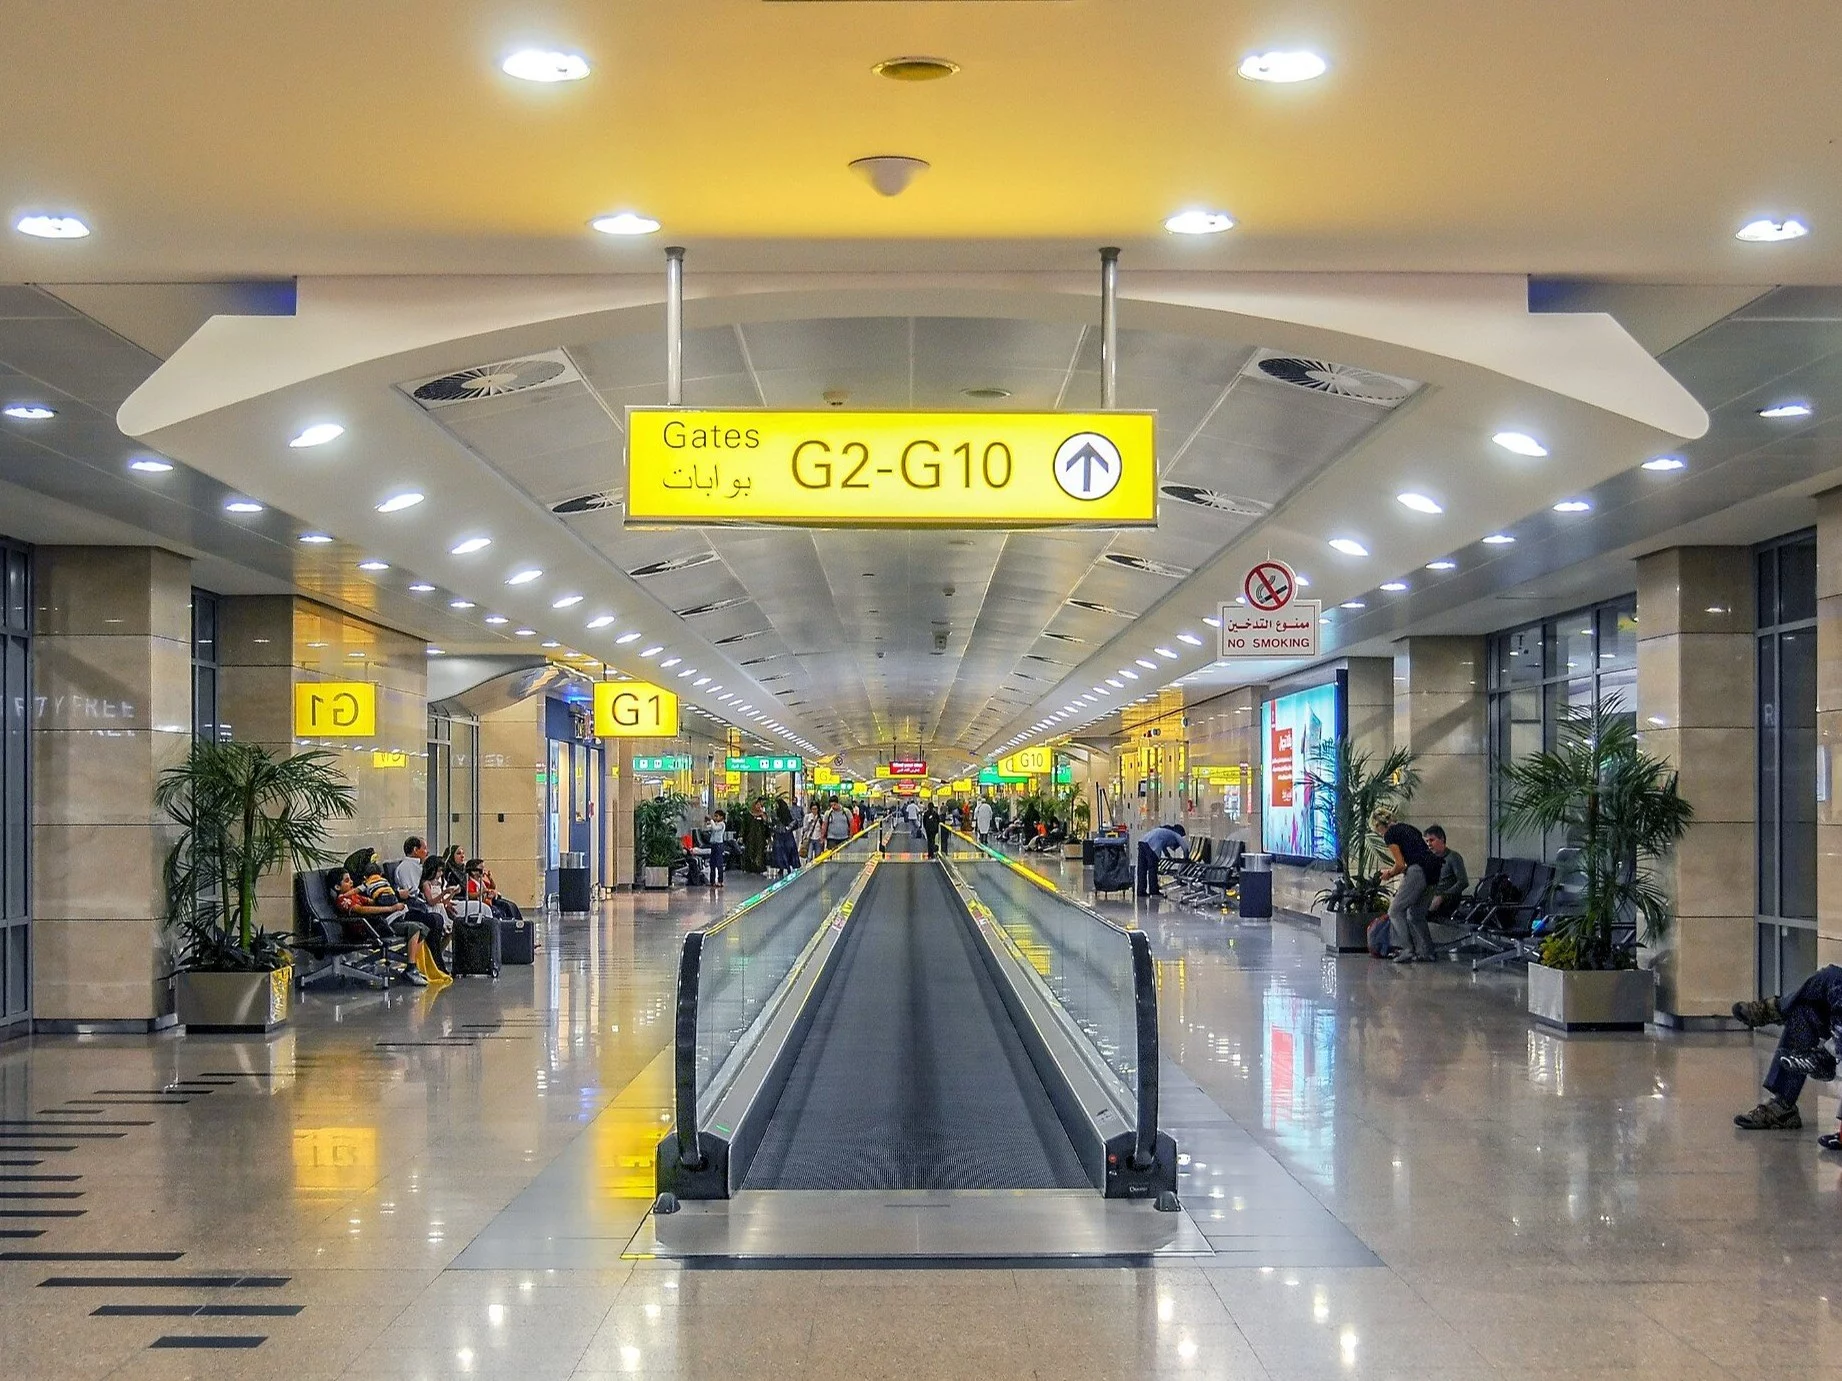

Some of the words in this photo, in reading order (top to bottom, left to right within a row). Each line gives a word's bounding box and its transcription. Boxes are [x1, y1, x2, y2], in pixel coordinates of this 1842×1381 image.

[663, 421, 760, 449] Gates
[791, 439, 1013, 490] G2-G10
[662, 464, 751, 498] بوابات
[1227, 638, 1245, 648] NO
[1253, 638, 1310, 648] SMOKING
[612, 693, 660, 726] G1
[1020, 752, 1043, 768] G10
